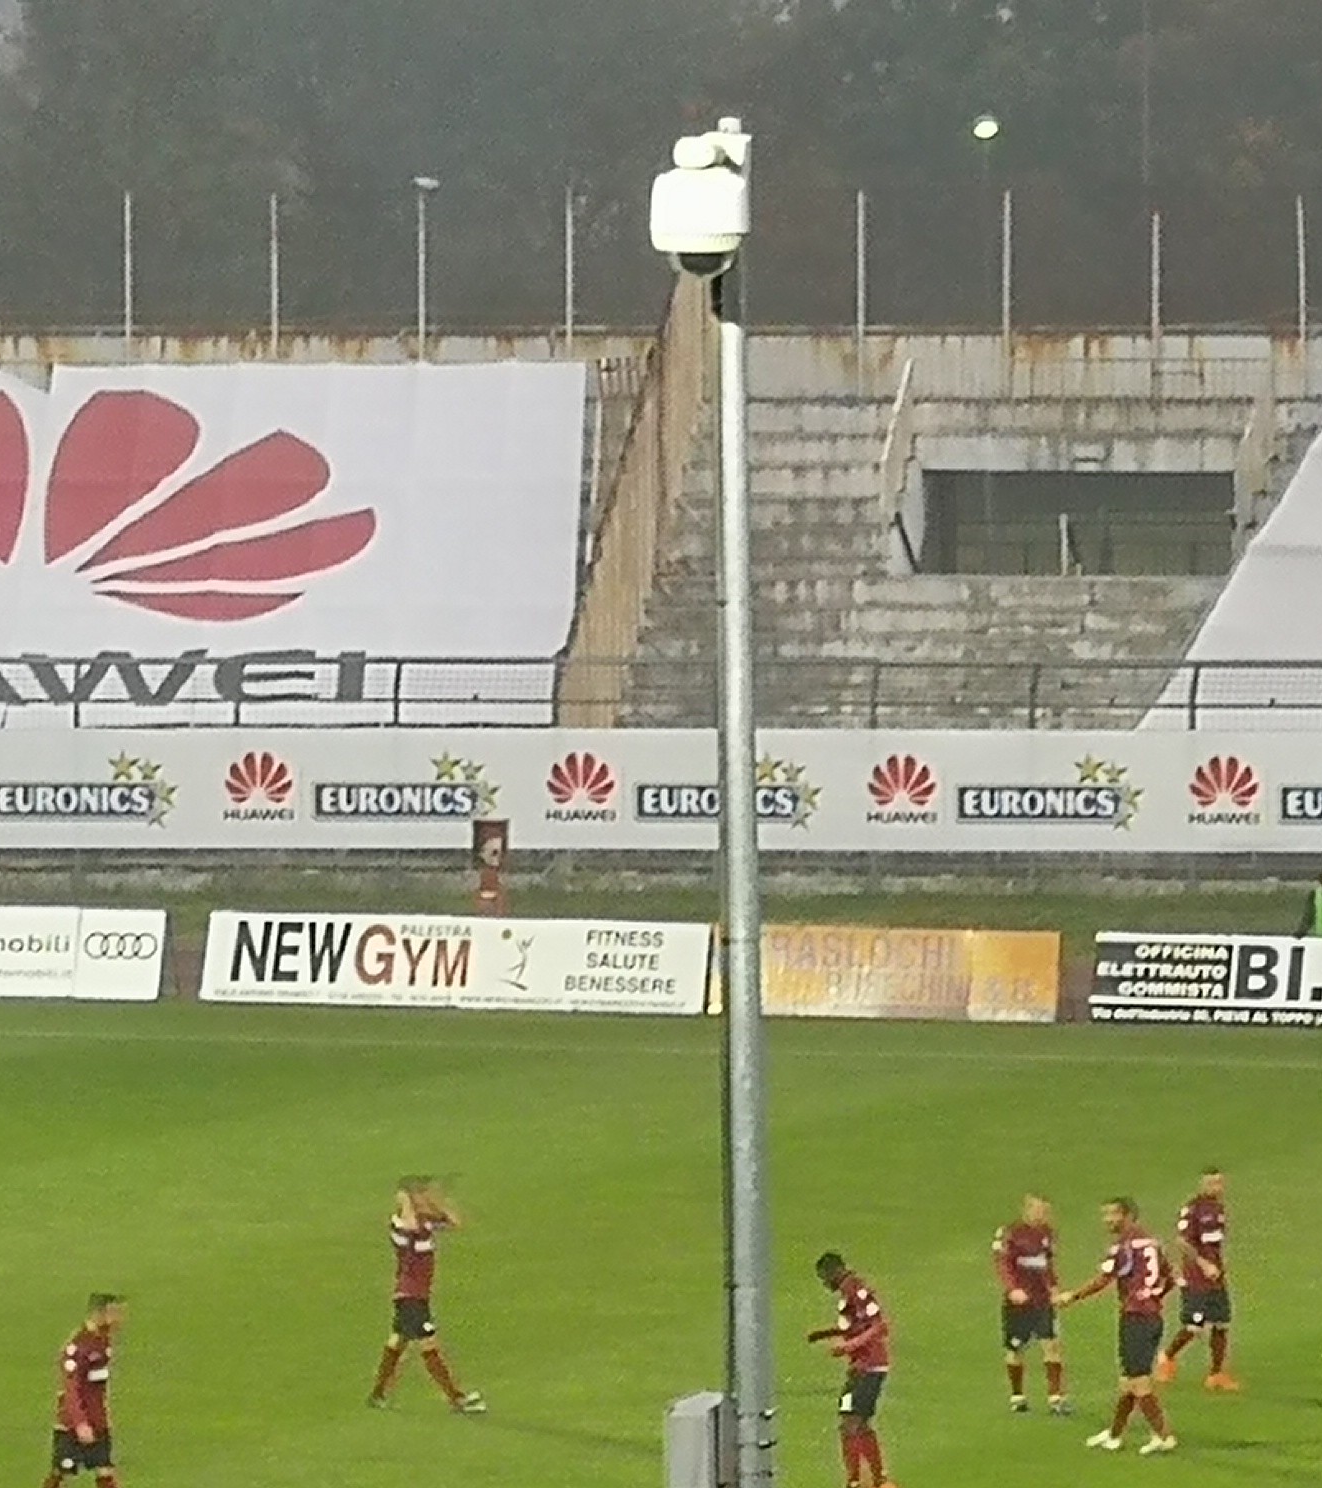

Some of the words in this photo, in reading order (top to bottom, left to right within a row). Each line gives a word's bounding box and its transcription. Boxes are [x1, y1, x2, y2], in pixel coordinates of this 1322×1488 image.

[321, 786, 473, 814] EURONICS
[643, 788, 794, 814] EUROCS
[964, 789, 1115, 817] EURONICS
[223, 809, 295, 821] HUAWEI
[545, 809, 616, 822] HUAWEI
[866, 812, 937, 824] HUAWEI
[1188, 812, 1260, 825] HUAWEI
[401, 925, 472, 936] PALESTRA
[586, 930, 664, 947] FITNESS
[1135, 944, 1228, 960] OFFICINA
[586, 953, 659, 971] SALUTE
[1097, 962, 1227, 980] ELETTRAUTO
[564, 975, 676, 995] BENESSERE
[1118, 982, 1224, 999] GOMMISTA
